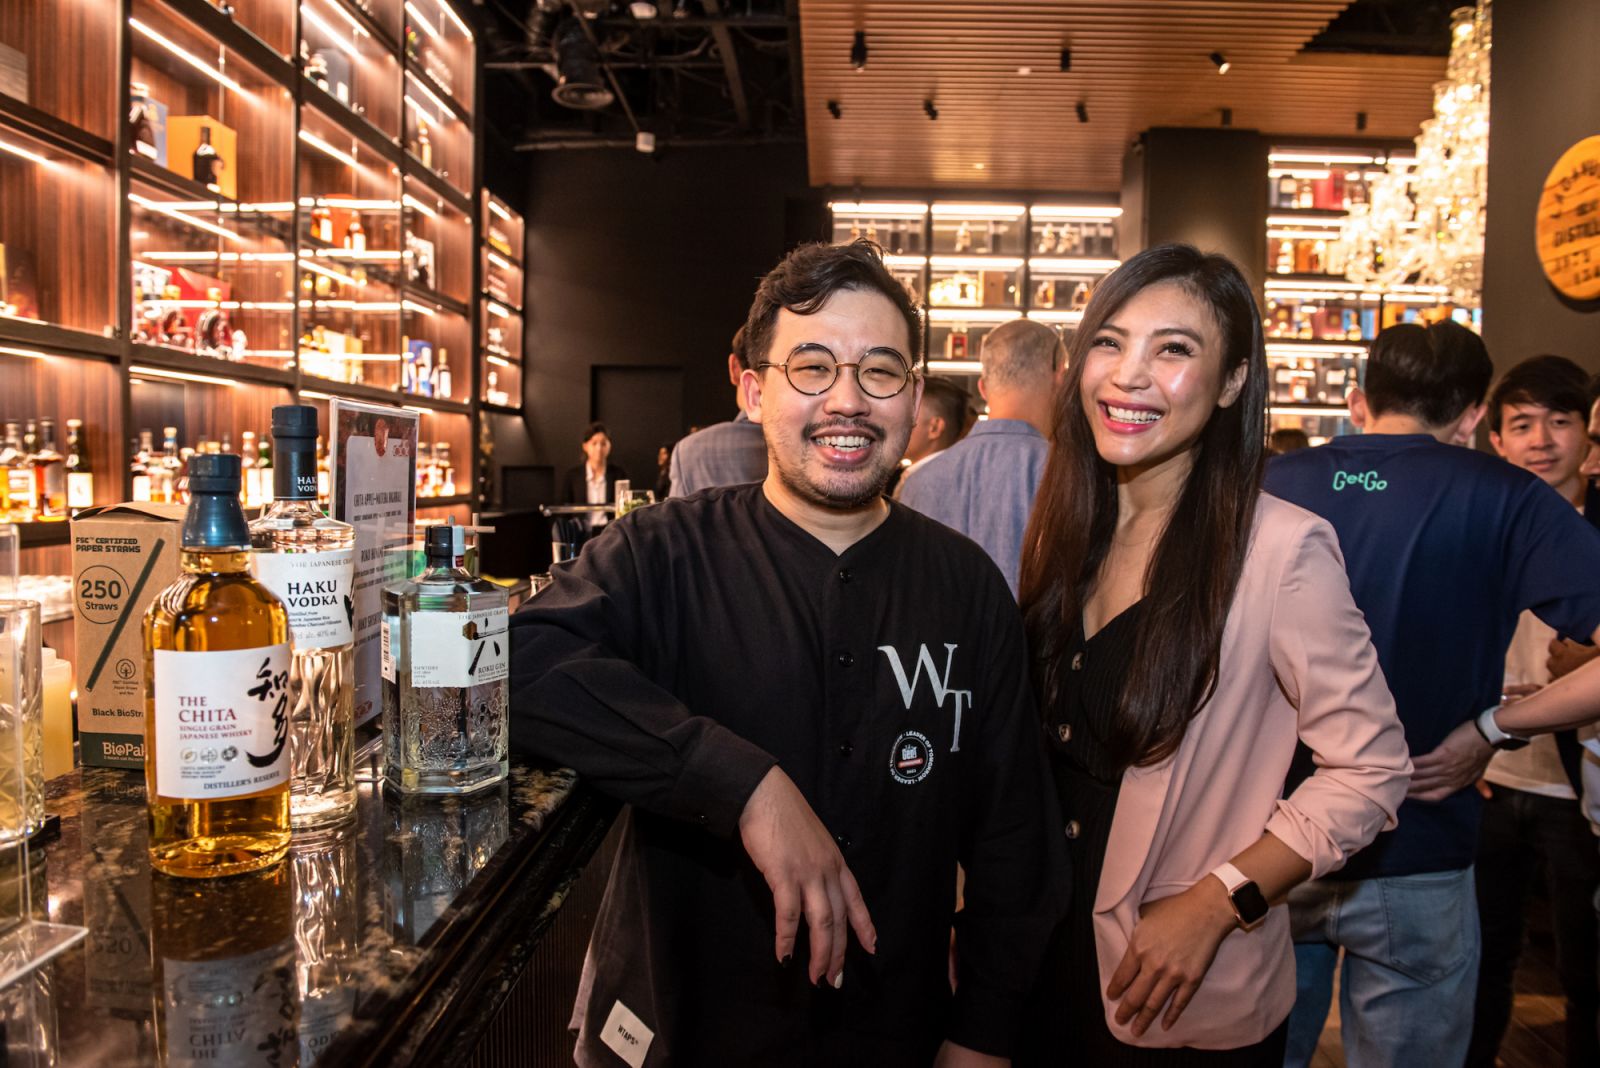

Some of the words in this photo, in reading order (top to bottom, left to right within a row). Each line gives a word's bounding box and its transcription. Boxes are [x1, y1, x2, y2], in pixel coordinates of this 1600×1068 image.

[1332, 470, 1388, 492] GetGo
[95, 537, 138, 545] CERTIFIED
[105, 545, 141, 553] STRAWS
[81, 579, 121, 599] 250
[287, 580, 337, 595] HAKU
[85, 601, 119, 611] Straws
[288, 595, 338, 608] VODKA
[478, 664, 495, 674] ROKU
[178, 696, 208, 706] THE
[92, 707, 116, 717] Black
[178, 707, 238, 723] CHITA
[209, 724, 237, 732] GRAIN
[179, 732, 219, 740] JAPANESE
[220, 729, 253, 738] WHISKY
[203, 778, 252, 790] DISTILLER'S
